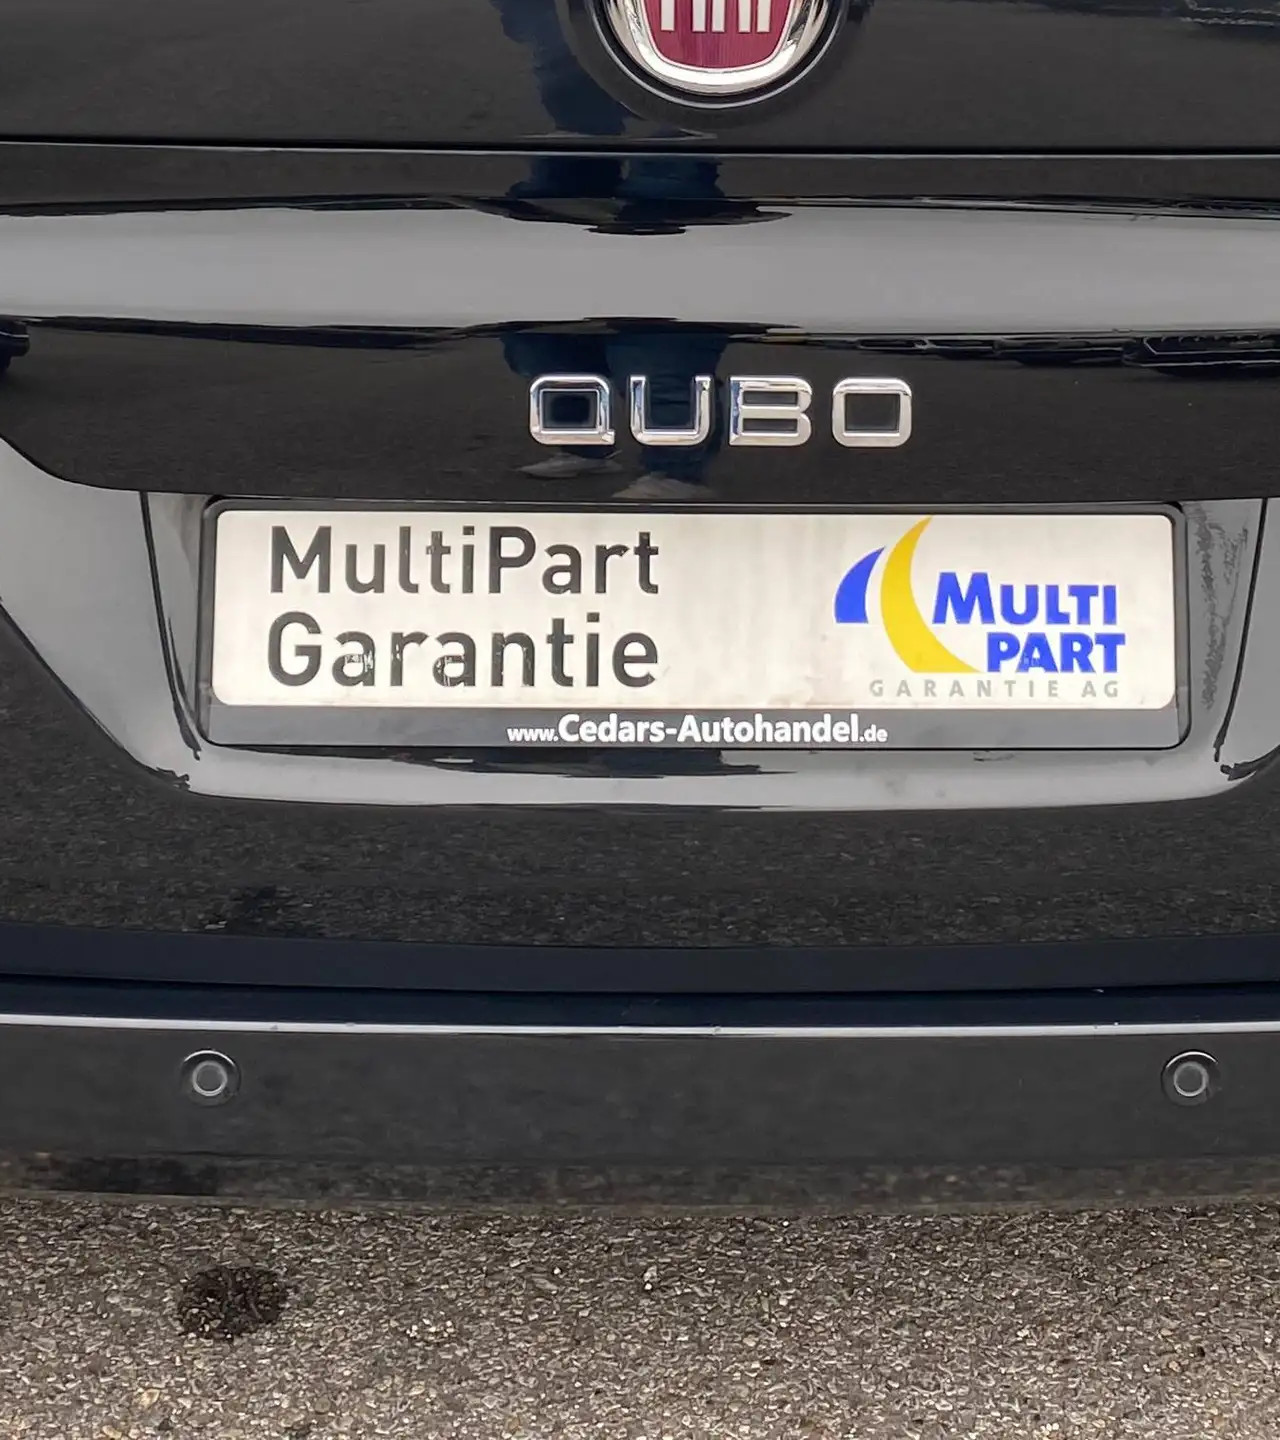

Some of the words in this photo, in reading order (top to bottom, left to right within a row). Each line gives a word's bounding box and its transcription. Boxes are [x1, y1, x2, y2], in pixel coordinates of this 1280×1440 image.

[528, 374, 914, 448] QUBO
[269, 524, 660, 594] MultiPart
[932, 571, 1118, 625] MULTI
[267, 610, 659, 688] Garantie
[986, 631, 1127, 674] PART
[869, 679, 1060, 699] GARANTIE
[1081, 679, 1120, 699] AG
[506, 712, 889, 744] www.Cedars-Autohandel.de
